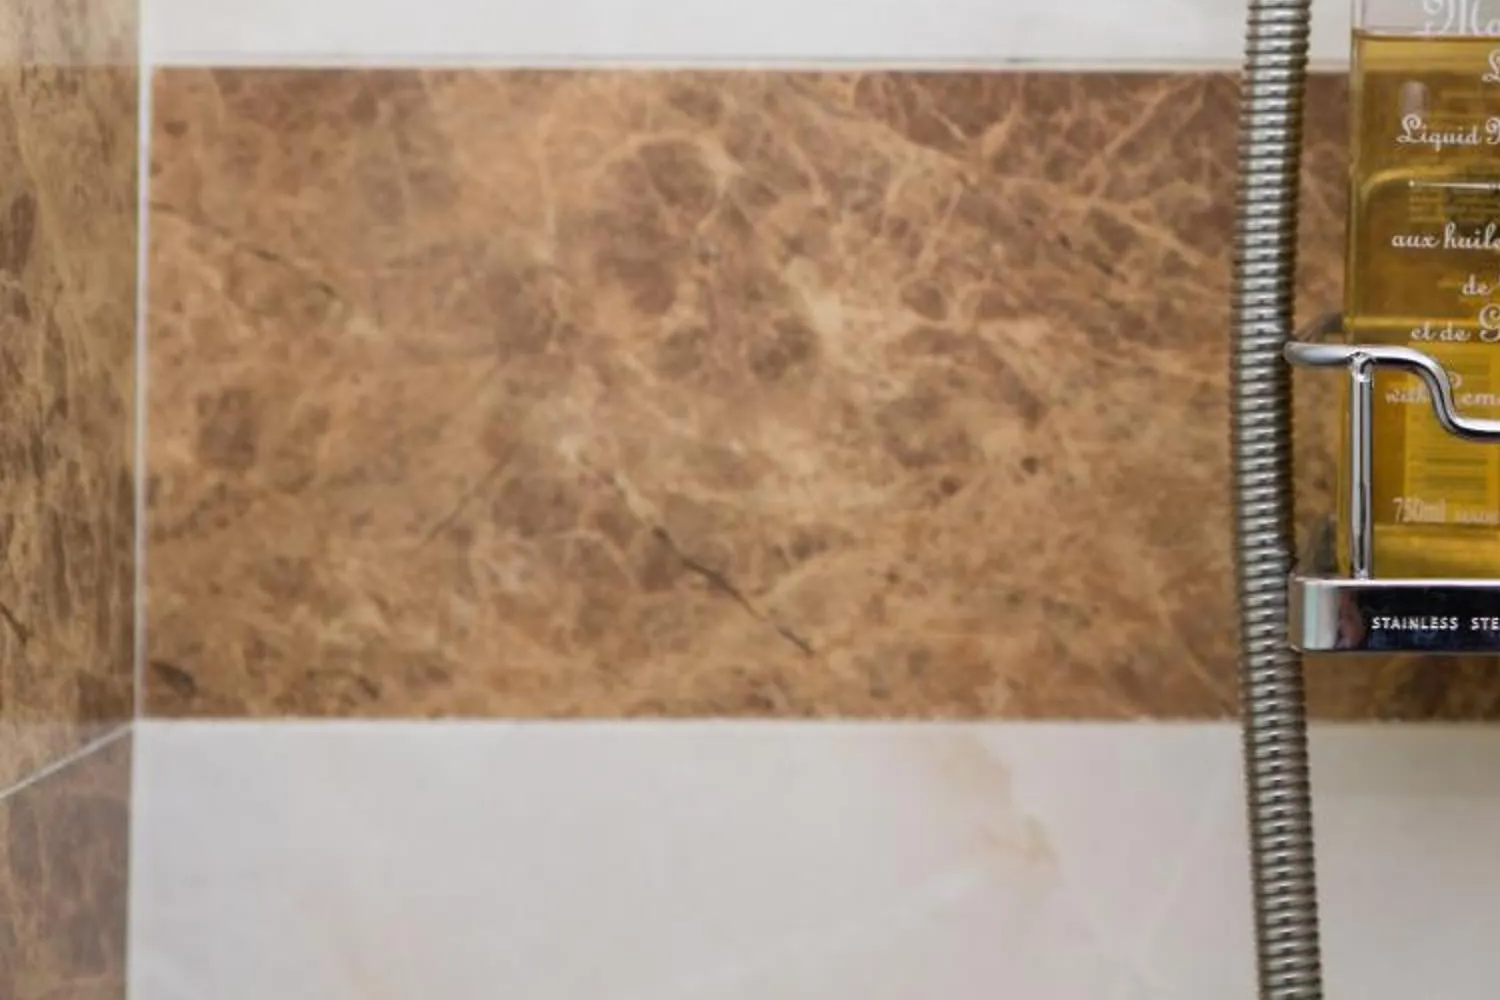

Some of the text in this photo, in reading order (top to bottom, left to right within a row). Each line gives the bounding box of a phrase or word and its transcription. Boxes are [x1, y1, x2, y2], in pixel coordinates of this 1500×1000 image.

[1396, 113, 1481, 151] Liquid
[1392, 234, 1439, 248] aux
[1462, 274, 1490, 296] de
[1411, 321, 1438, 341] et
[1439, 321, 1471, 341] de
[1371, 616, 1459, 631] STAINLESS
